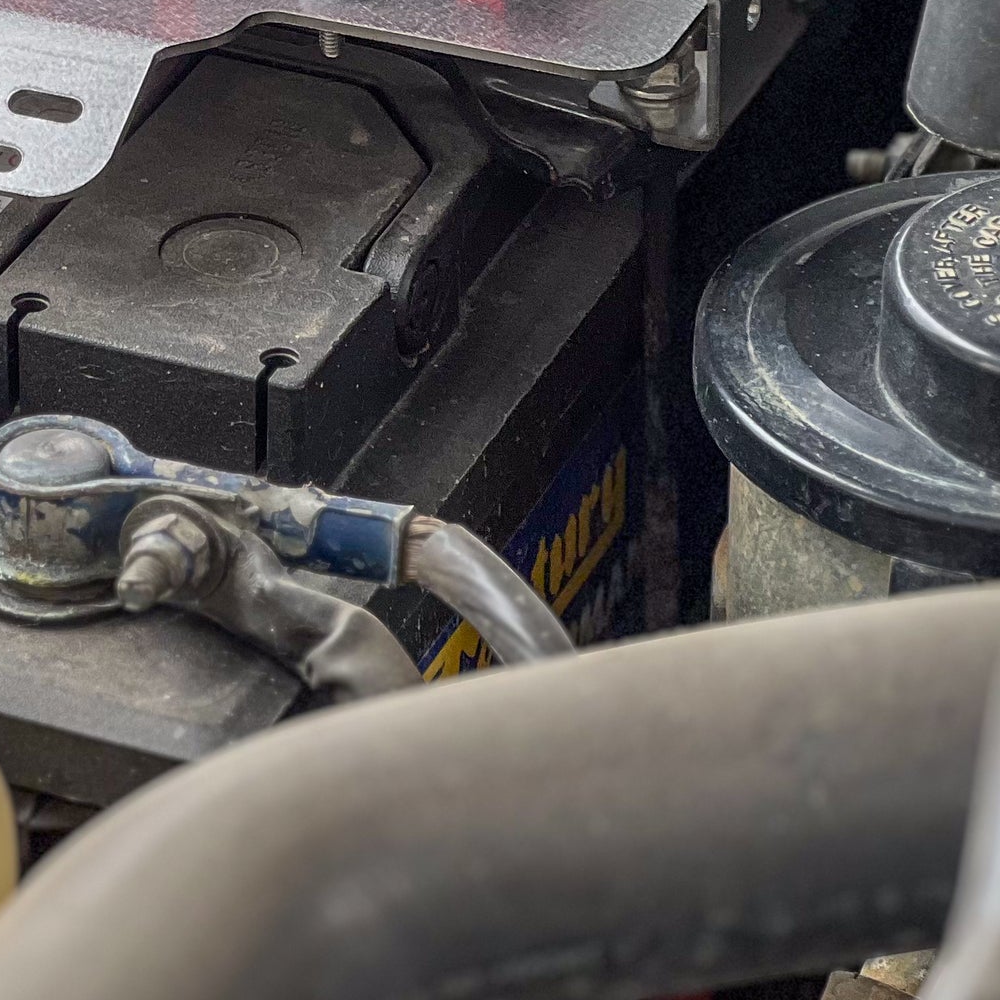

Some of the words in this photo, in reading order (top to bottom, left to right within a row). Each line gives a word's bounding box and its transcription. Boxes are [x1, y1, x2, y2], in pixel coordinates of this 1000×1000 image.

[930, 204, 991, 254] AFTER
[933, 256, 984, 309] COVER
[968, 254, 999, 288] THE
